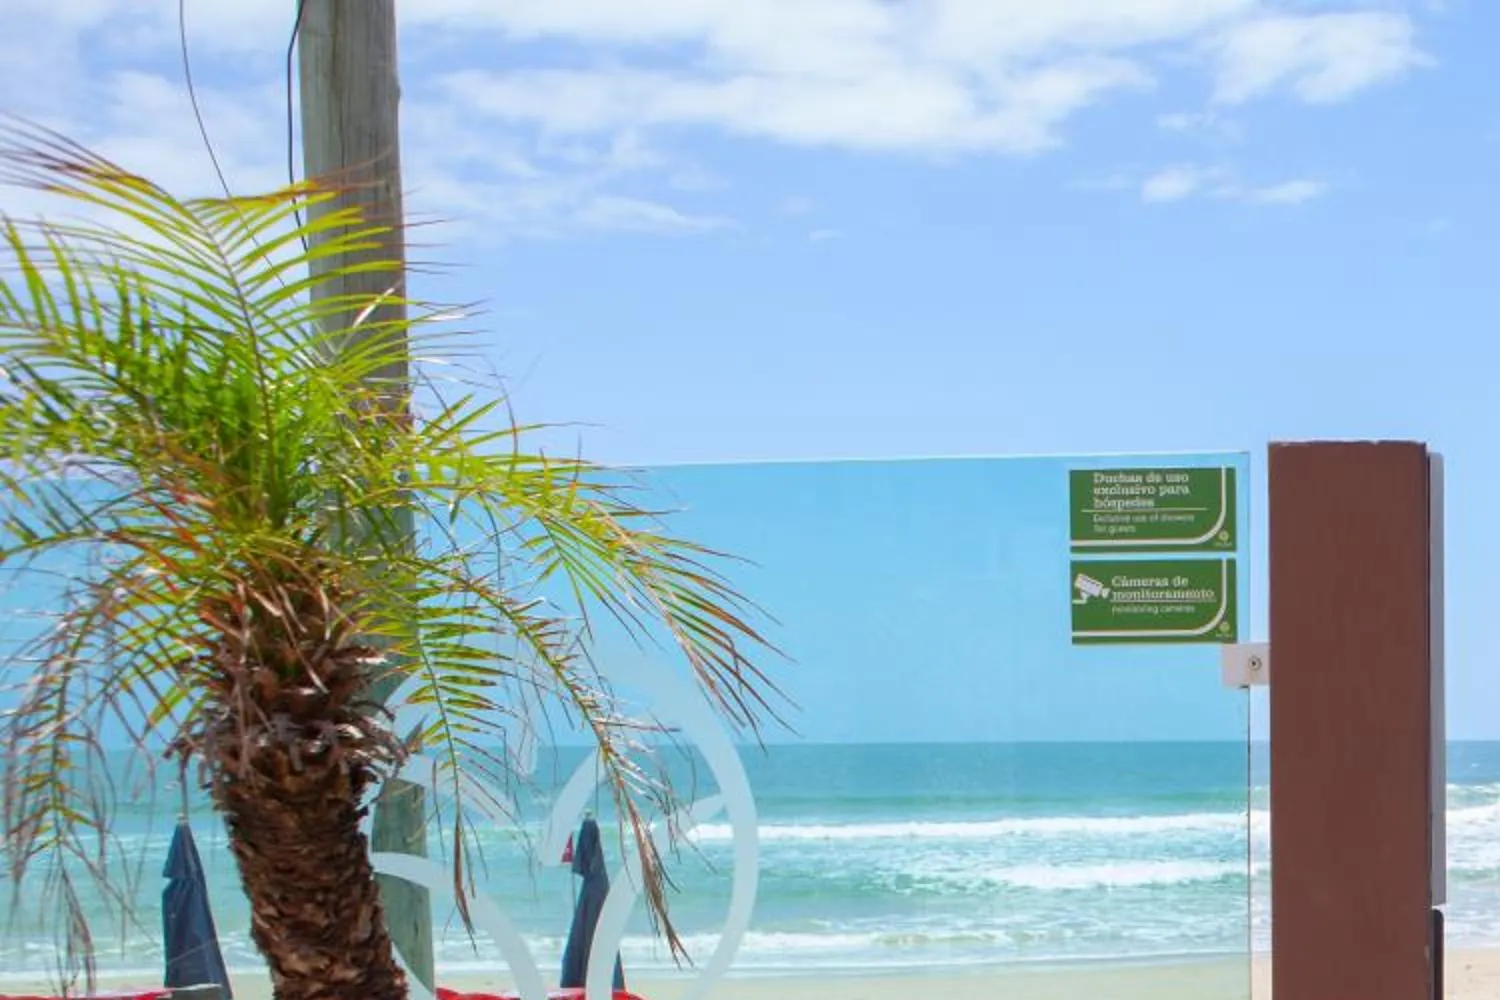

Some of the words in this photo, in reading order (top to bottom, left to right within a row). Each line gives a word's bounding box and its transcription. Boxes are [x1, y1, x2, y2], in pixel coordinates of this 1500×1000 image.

[1093, 472, 1142, 484] Duchas
[1146, 472, 1162, 483] de
[1165, 472, 1189, 483] uso
[1093, 484, 1155, 495] exclusivo
[1159, 485, 1190, 497] para
[1093, 496, 1155, 511] hóspedes
[1171, 576, 1189, 587] de
[1112, 588, 1215, 600] monitoramento
